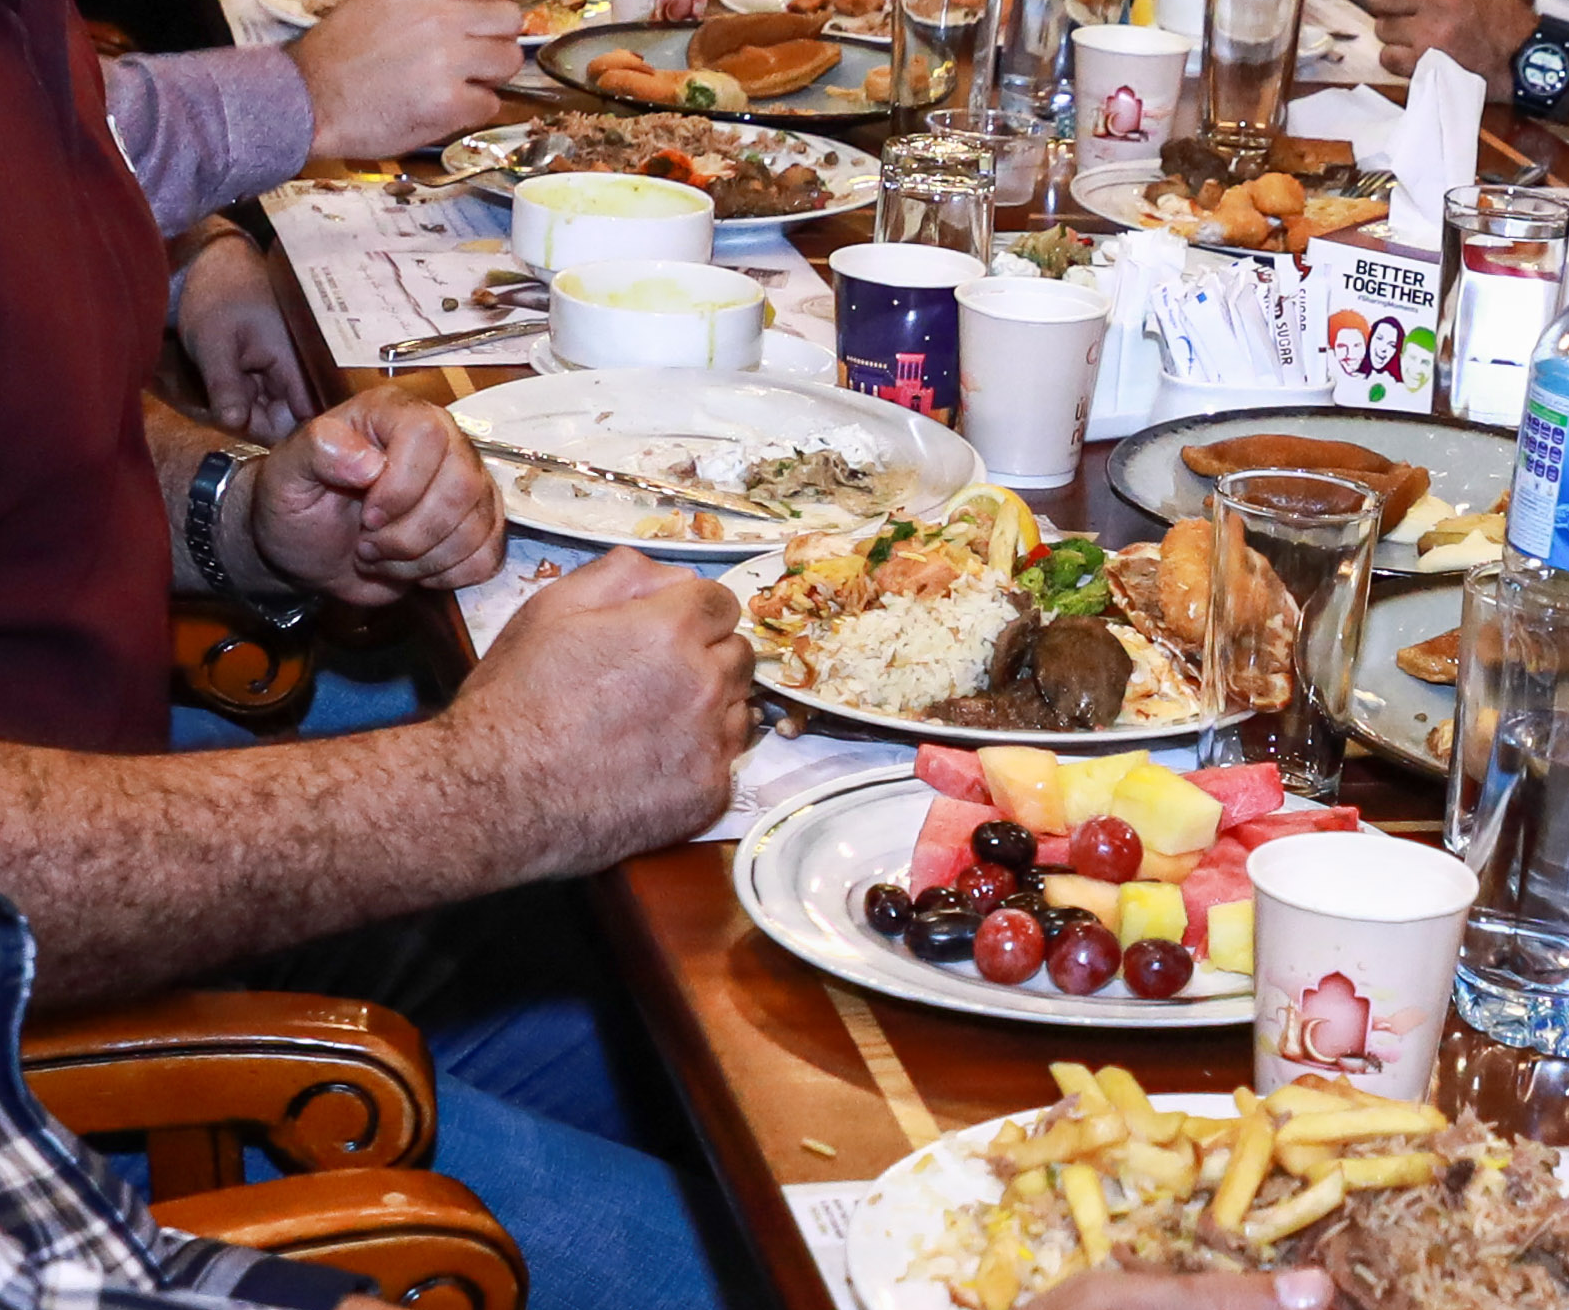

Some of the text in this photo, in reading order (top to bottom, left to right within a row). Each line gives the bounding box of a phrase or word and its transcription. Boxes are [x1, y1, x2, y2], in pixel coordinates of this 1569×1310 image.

[1343, 273, 1435, 308] TOGETHER
[1356, 259, 1425, 288] BETTER
[1276, 322, 1293, 366] SUGAR
